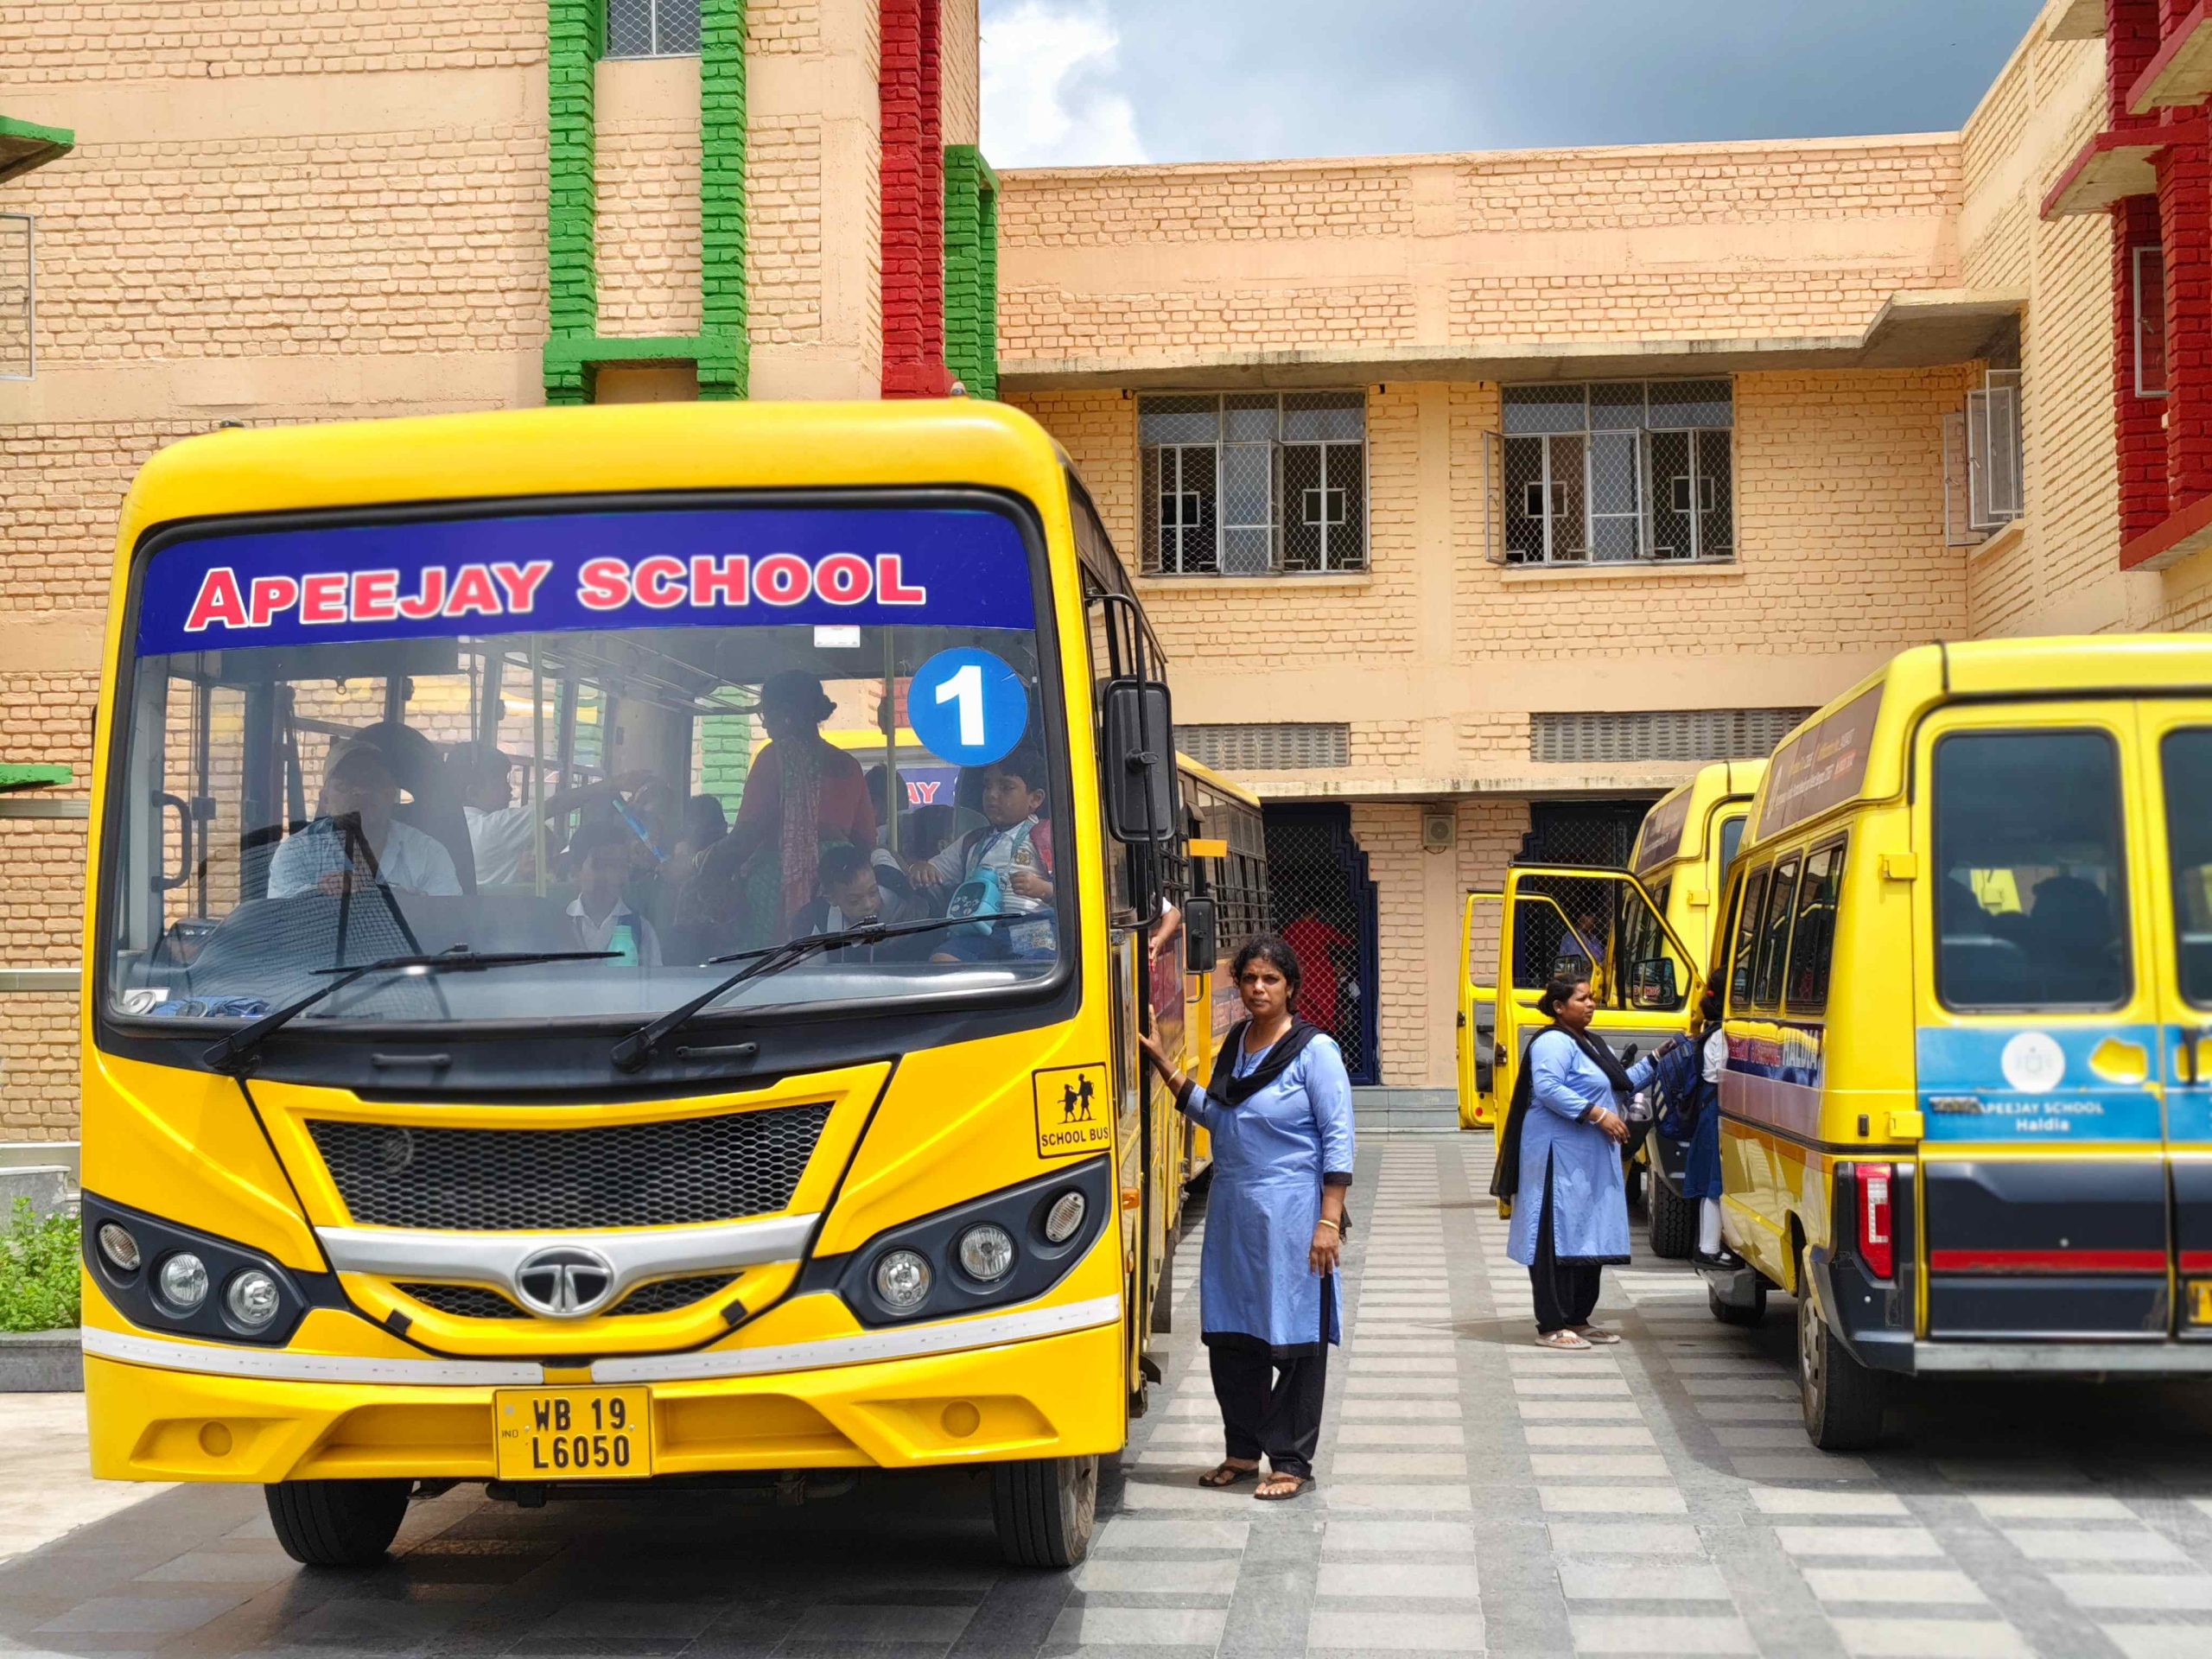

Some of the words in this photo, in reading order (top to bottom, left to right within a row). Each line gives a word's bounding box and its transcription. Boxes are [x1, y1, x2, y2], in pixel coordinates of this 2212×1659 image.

[184, 561, 552, 632] APEEJAY
[577, 553, 926, 610] SCHOOL
[935, 664, 985, 746] 1
[2044, 1102, 2105, 1116] SCHOOL
[1041, 1130, 1086, 1147] SCHOOL
[1090, 1128, 1109, 1141] BUS
[2016, 1118, 2070, 1132] Haldia
[533, 1399, 571, 1431] WB
[591, 1396, 626, 1431] 19
[501, 1430, 518, 1439] IND
[533, 1435, 630, 1468] L6050
